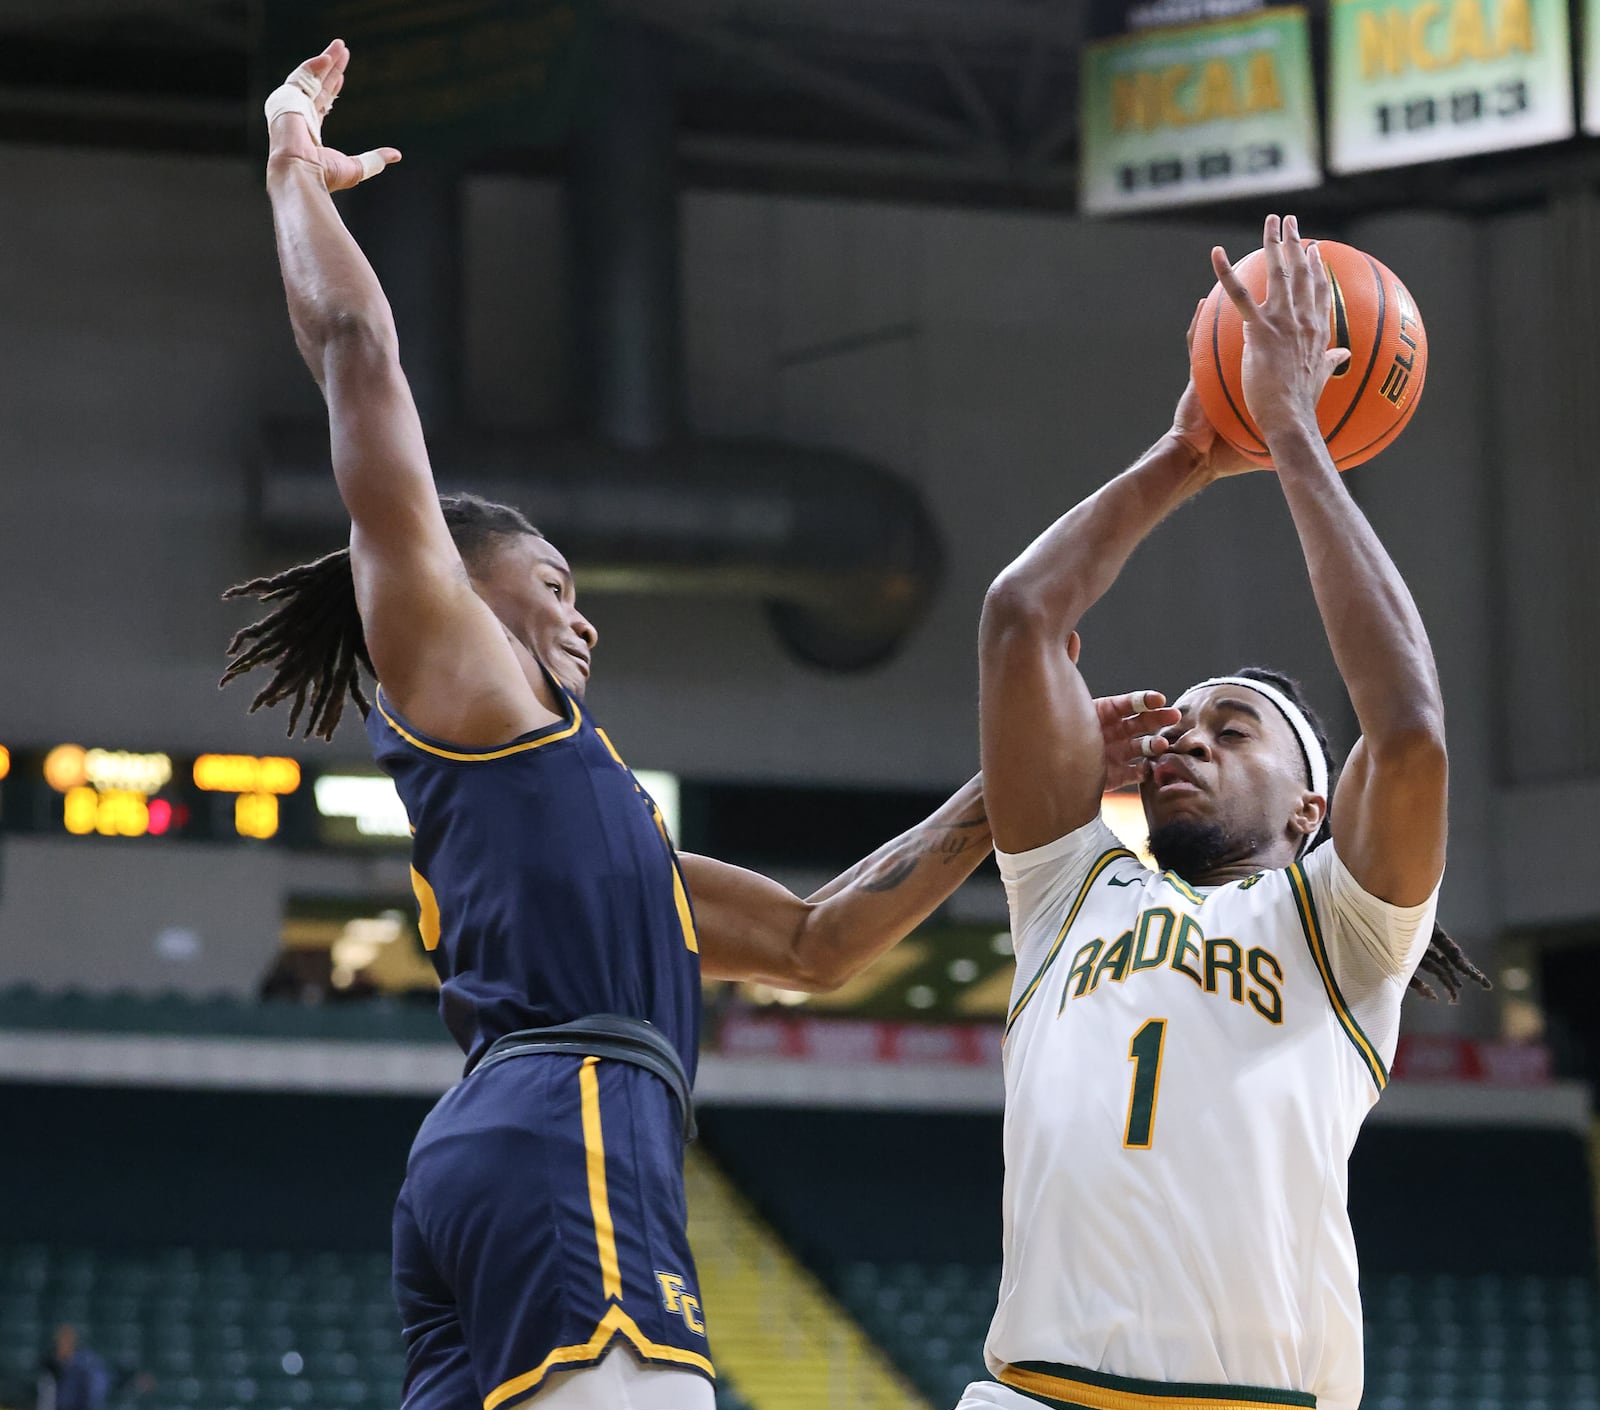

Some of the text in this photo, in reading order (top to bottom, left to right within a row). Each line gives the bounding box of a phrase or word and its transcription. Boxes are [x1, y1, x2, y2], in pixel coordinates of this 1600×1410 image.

[1361, 0, 1534, 82] NCAA
[1112, 50, 1283, 135] NCAA
[1057, 906, 1284, 1026] RADERS
[1123, 1017, 1168, 1150] 1
